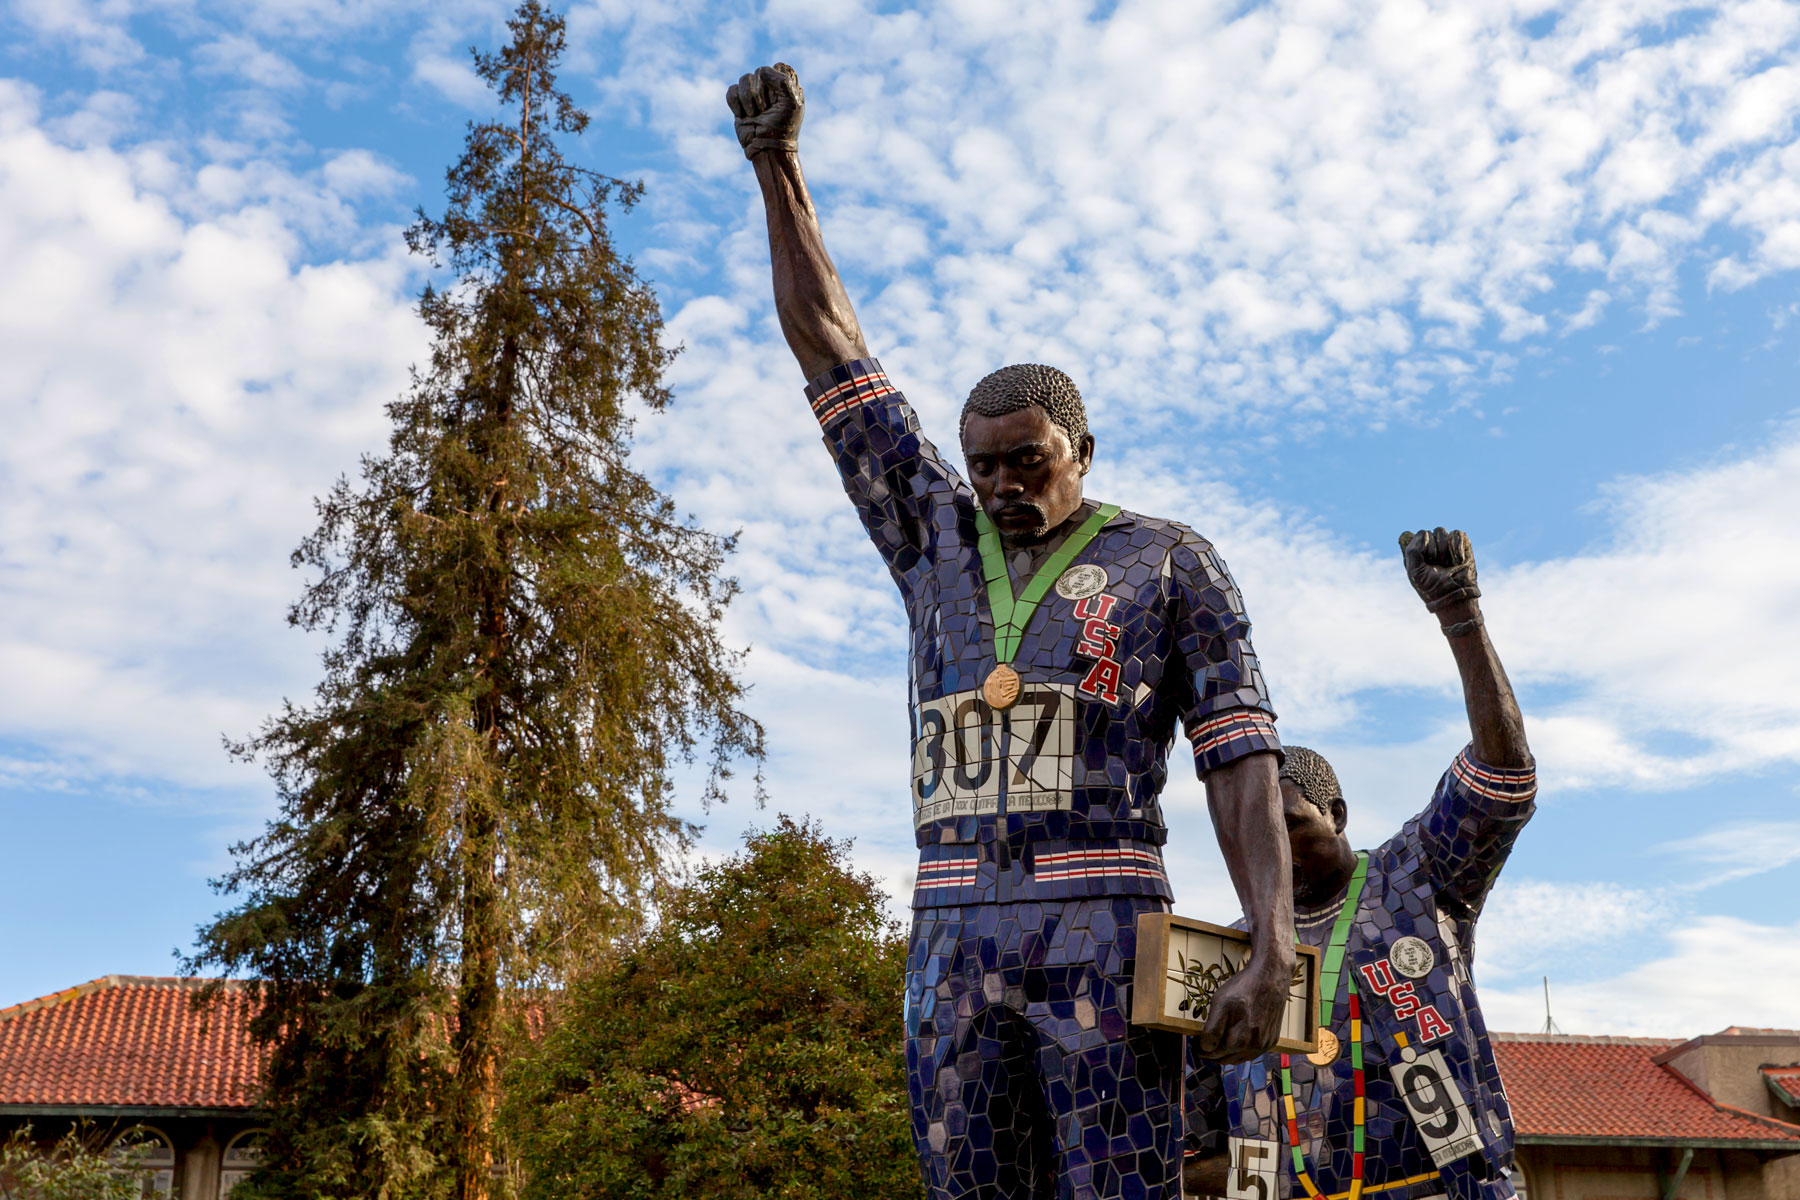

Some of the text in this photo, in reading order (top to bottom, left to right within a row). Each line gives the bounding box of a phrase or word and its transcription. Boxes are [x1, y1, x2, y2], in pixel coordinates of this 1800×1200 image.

[1073, 593, 1122, 705] USA
[916, 691, 1061, 799] 307
[1360, 959, 1454, 1044] USA
[1402, 1064, 1459, 1139] 9
[1237, 1145, 1269, 1200] 5
